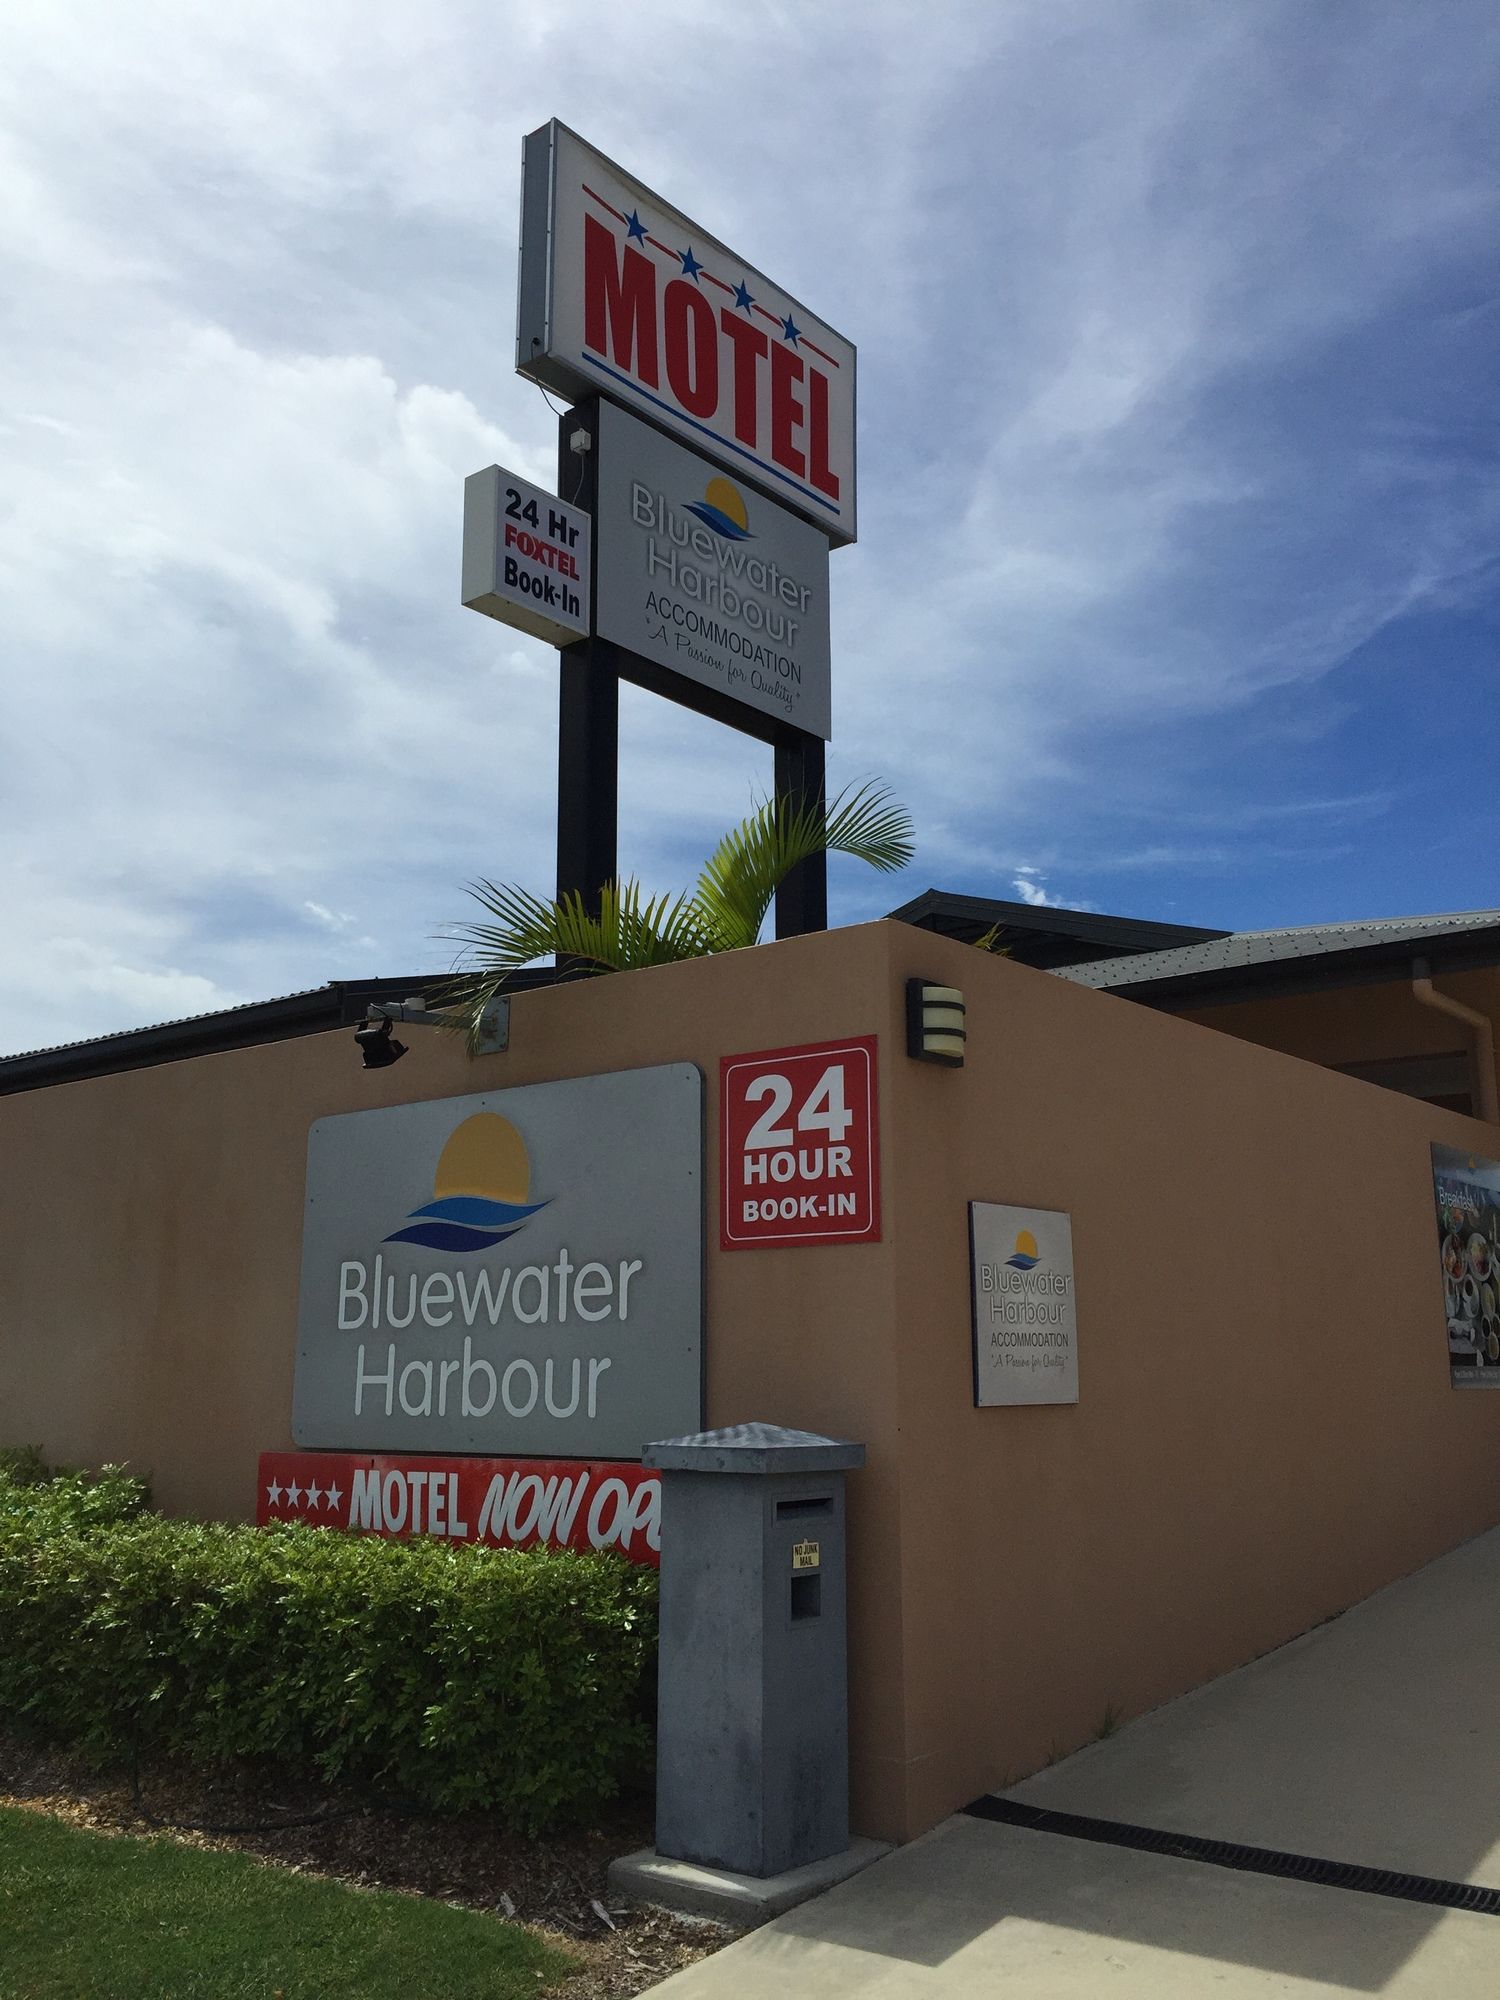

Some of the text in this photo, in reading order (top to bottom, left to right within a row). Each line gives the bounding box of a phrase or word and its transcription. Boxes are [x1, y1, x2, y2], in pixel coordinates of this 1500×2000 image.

[585, 212, 839, 501] MOTEL
[505, 488, 579, 548] 24 Hr
[632, 481, 811, 612] Bluewater
[505, 523, 580, 581] FOXTEL
[505, 556, 580, 617] Book-In
[648, 538, 799, 647] Harbour
[645, 591, 801, 684] ACCOMMODATION
[675, 633, 725, 672] Passion
[728, 658, 747, 685] for
[744, 1065, 852, 1150] 24
[744, 1146, 853, 1185] HOUR
[743, 1193, 856, 1222] BOOK-IN
[1439, 1186, 1474, 1210] Breakfast
[338, 1248, 642, 1329] Bluewater
[981, 1264, 1071, 1296] Bluewater
[990, 1296, 1066, 1324] Harbour
[991, 1332, 1069, 1347] ACCOMMODATION
[354, 1336, 611, 1418] Harbour
[348, 1468, 468, 1537] MOTEL
[477, 1471, 590, 1545] NOW
[794, 1543, 818, 1555] NO JUNK
[799, 1555, 813, 1567] MAIL
